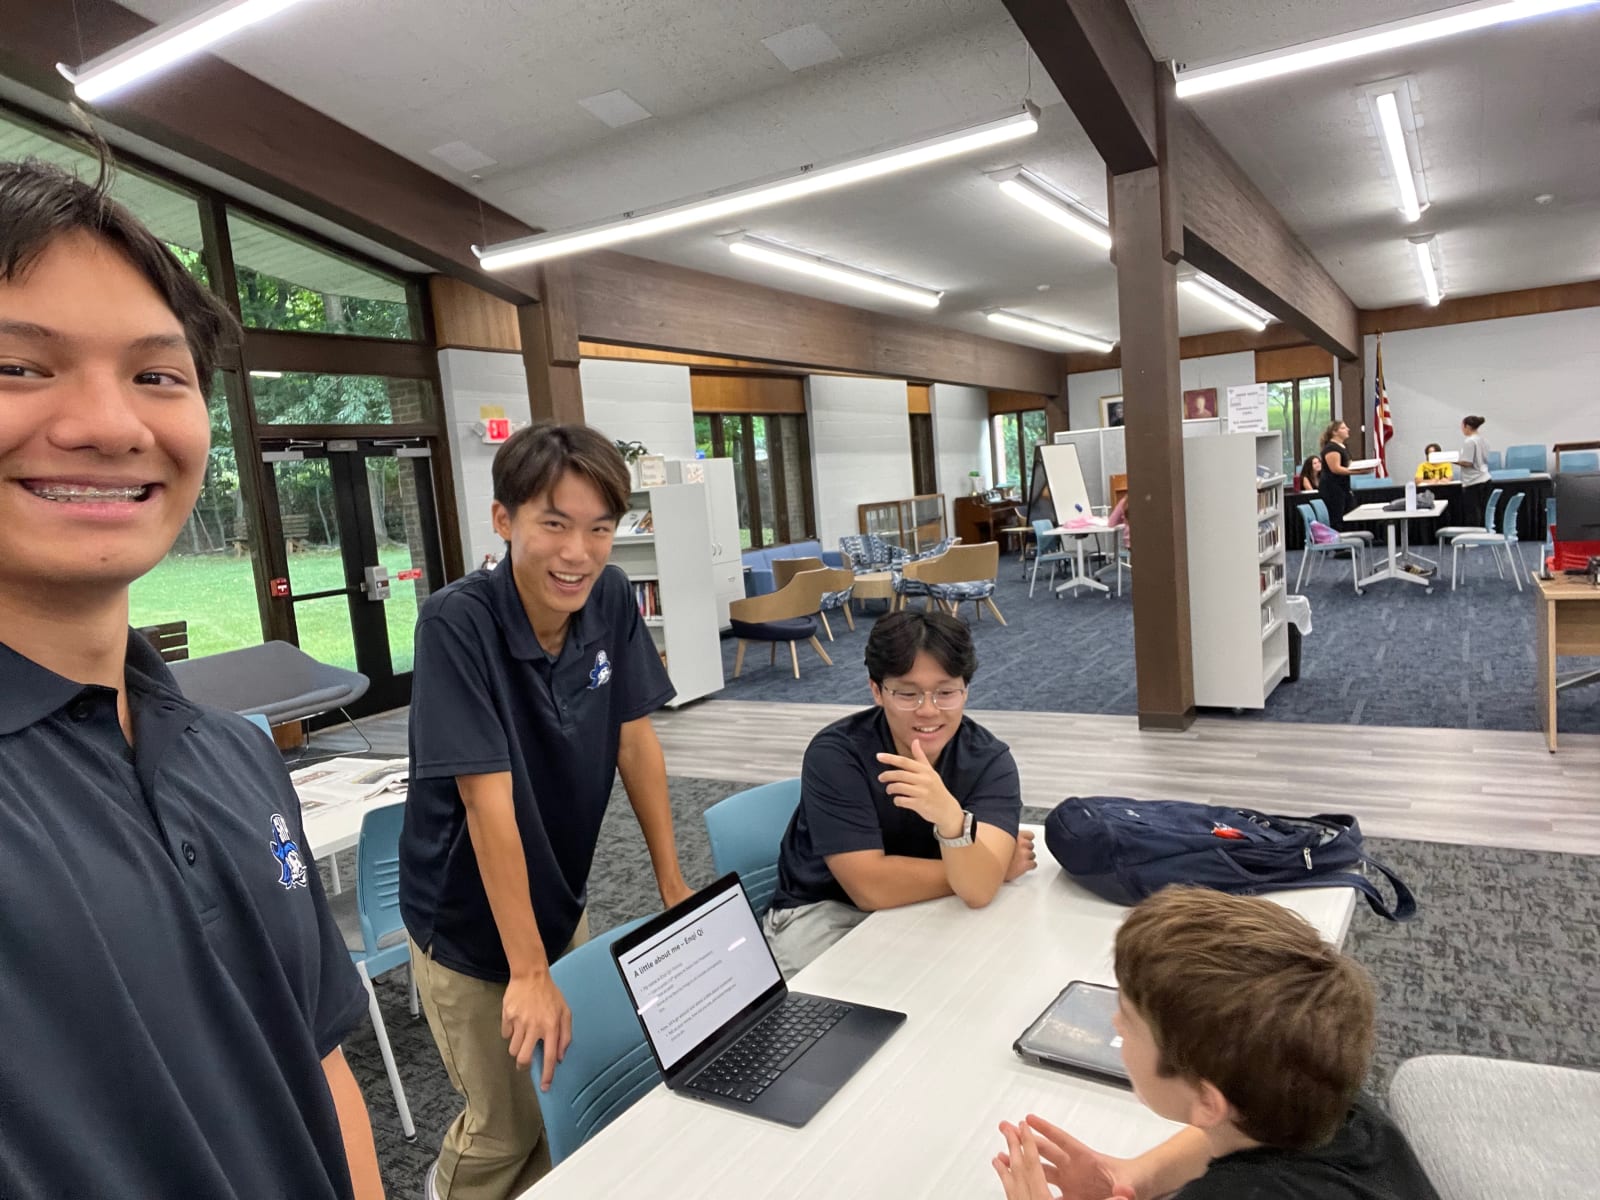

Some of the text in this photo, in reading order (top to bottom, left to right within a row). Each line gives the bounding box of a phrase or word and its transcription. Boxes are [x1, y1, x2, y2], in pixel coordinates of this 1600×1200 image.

[634, 970, 640, 978] A
[638, 962, 654, 974] little
[654, 950, 671, 965] about
[671, 944, 681, 953] me
